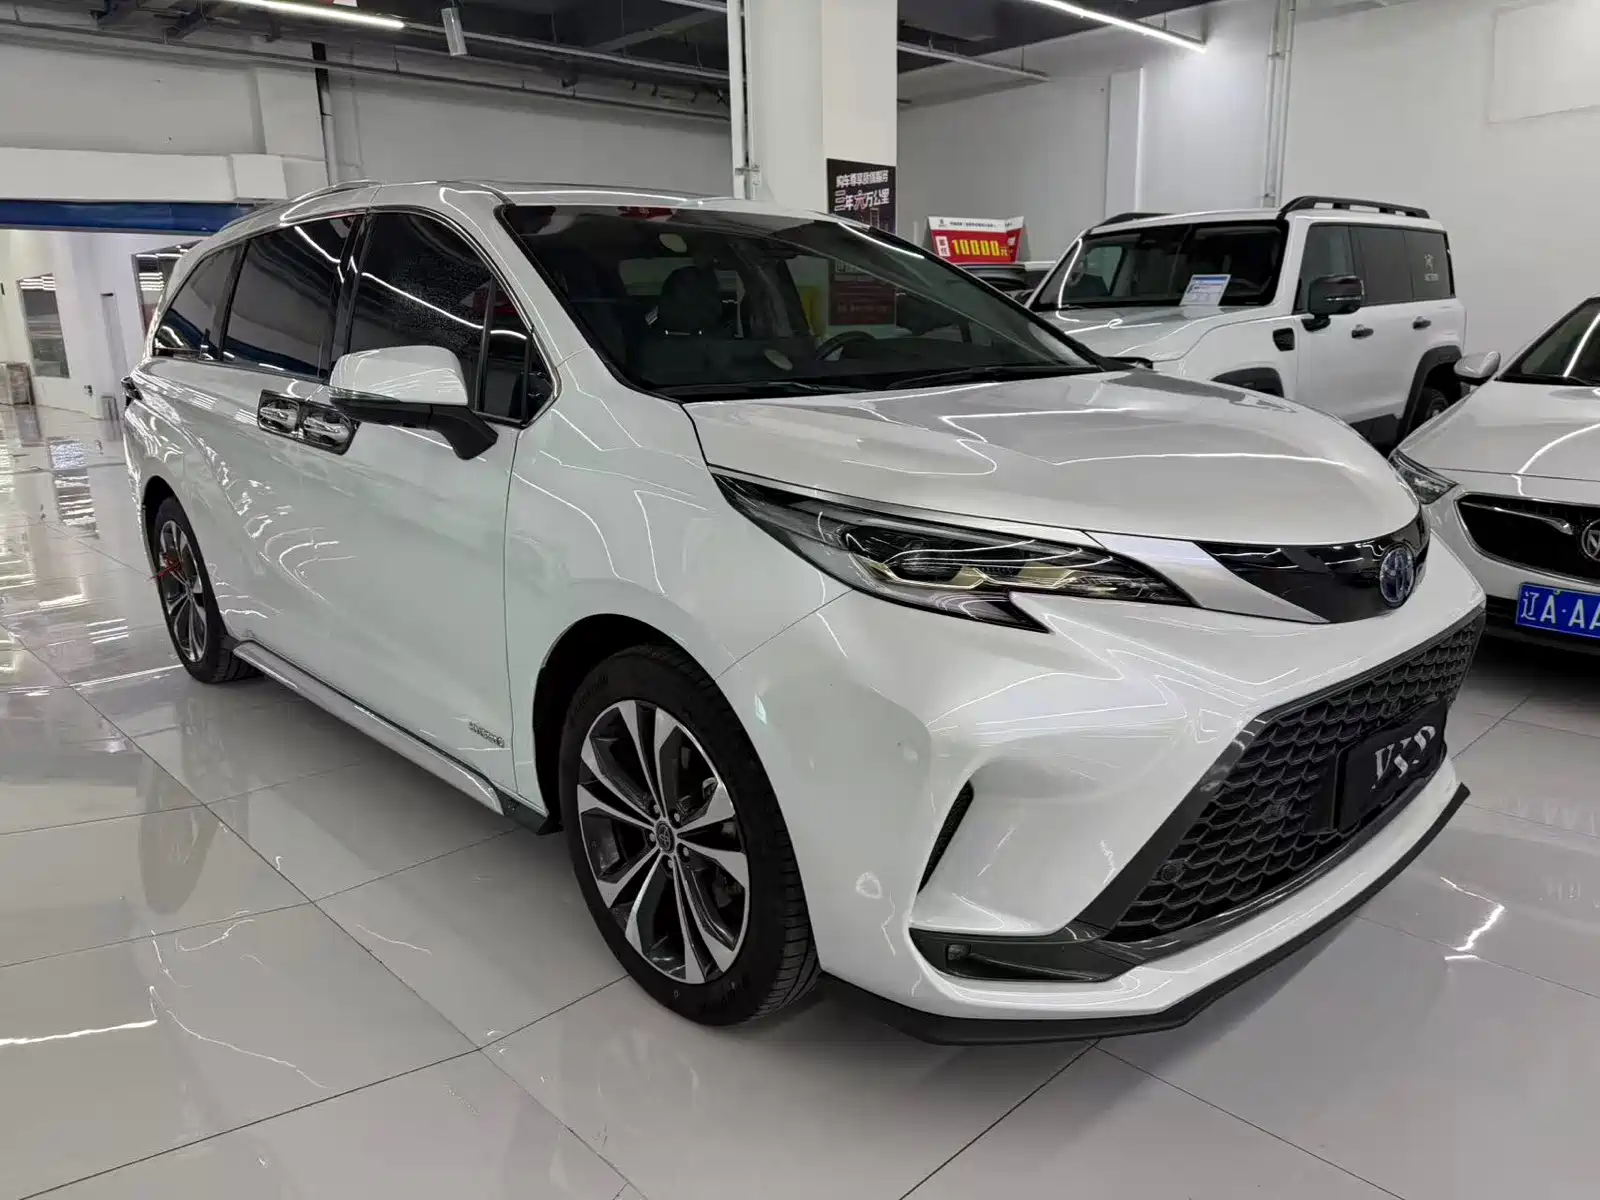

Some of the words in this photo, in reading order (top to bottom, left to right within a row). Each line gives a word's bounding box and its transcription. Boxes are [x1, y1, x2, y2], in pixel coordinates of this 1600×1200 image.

[834, 188, 890, 212] 三年六万公里
